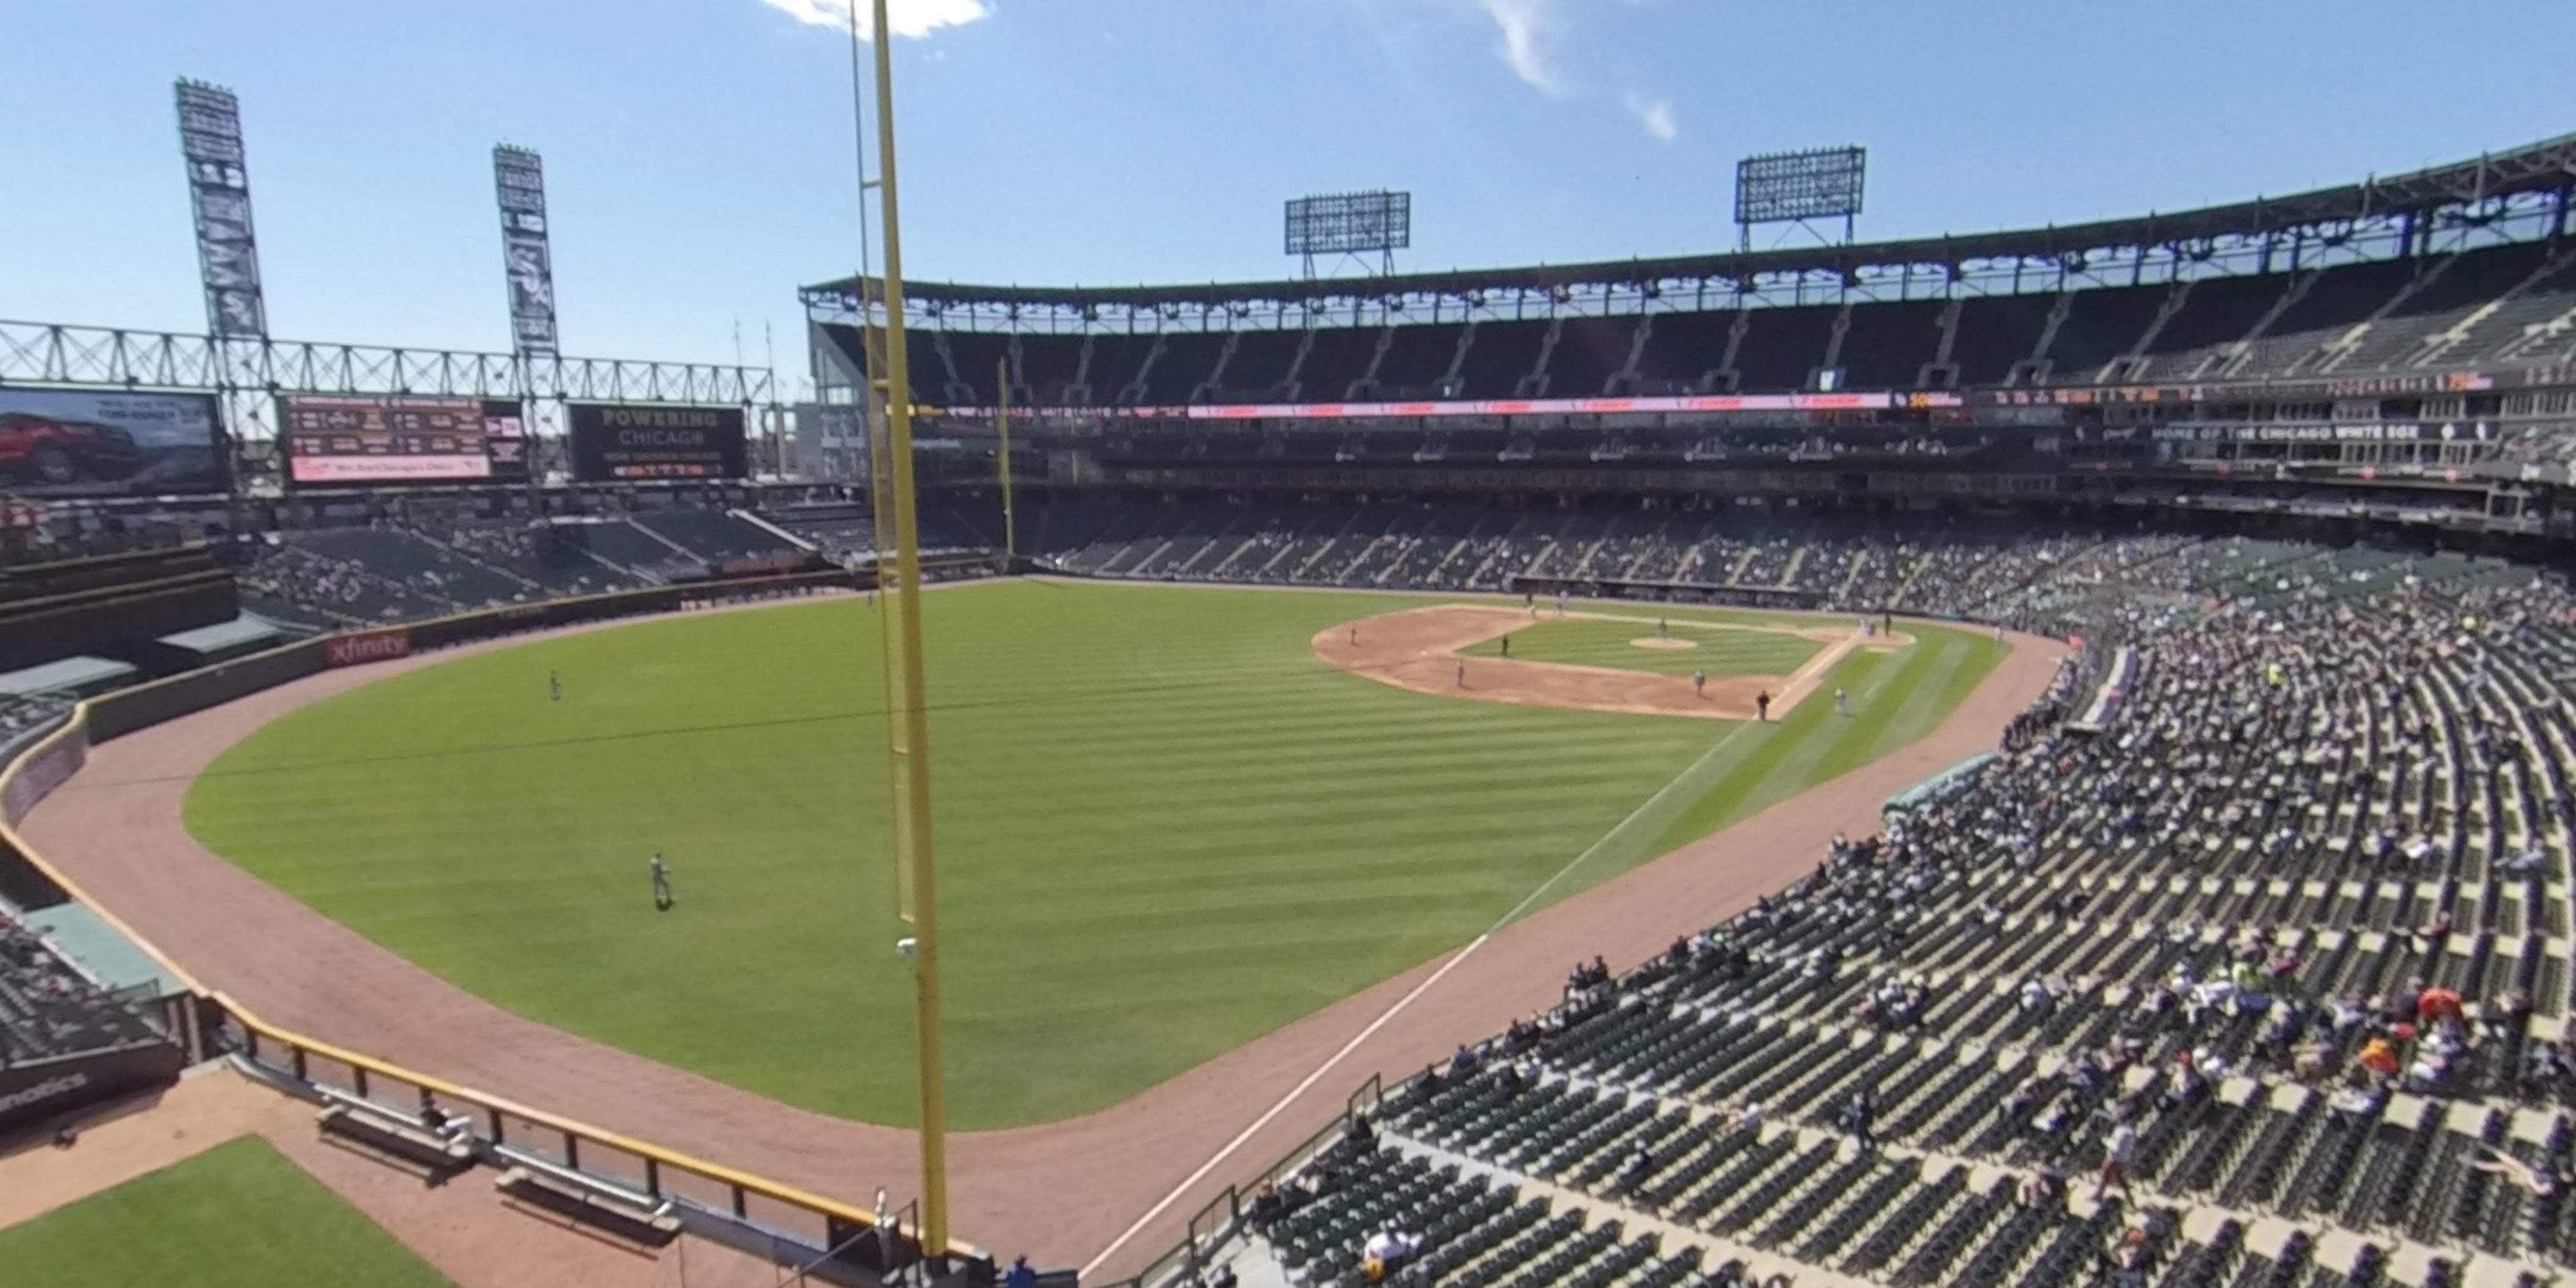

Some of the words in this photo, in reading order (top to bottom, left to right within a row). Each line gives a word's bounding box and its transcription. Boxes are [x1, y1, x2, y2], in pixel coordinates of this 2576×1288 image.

[602, 409, 719, 427] POWERING
[619, 430, 705, 447] CHICAGO
[333, 636, 406, 663] xfinity
